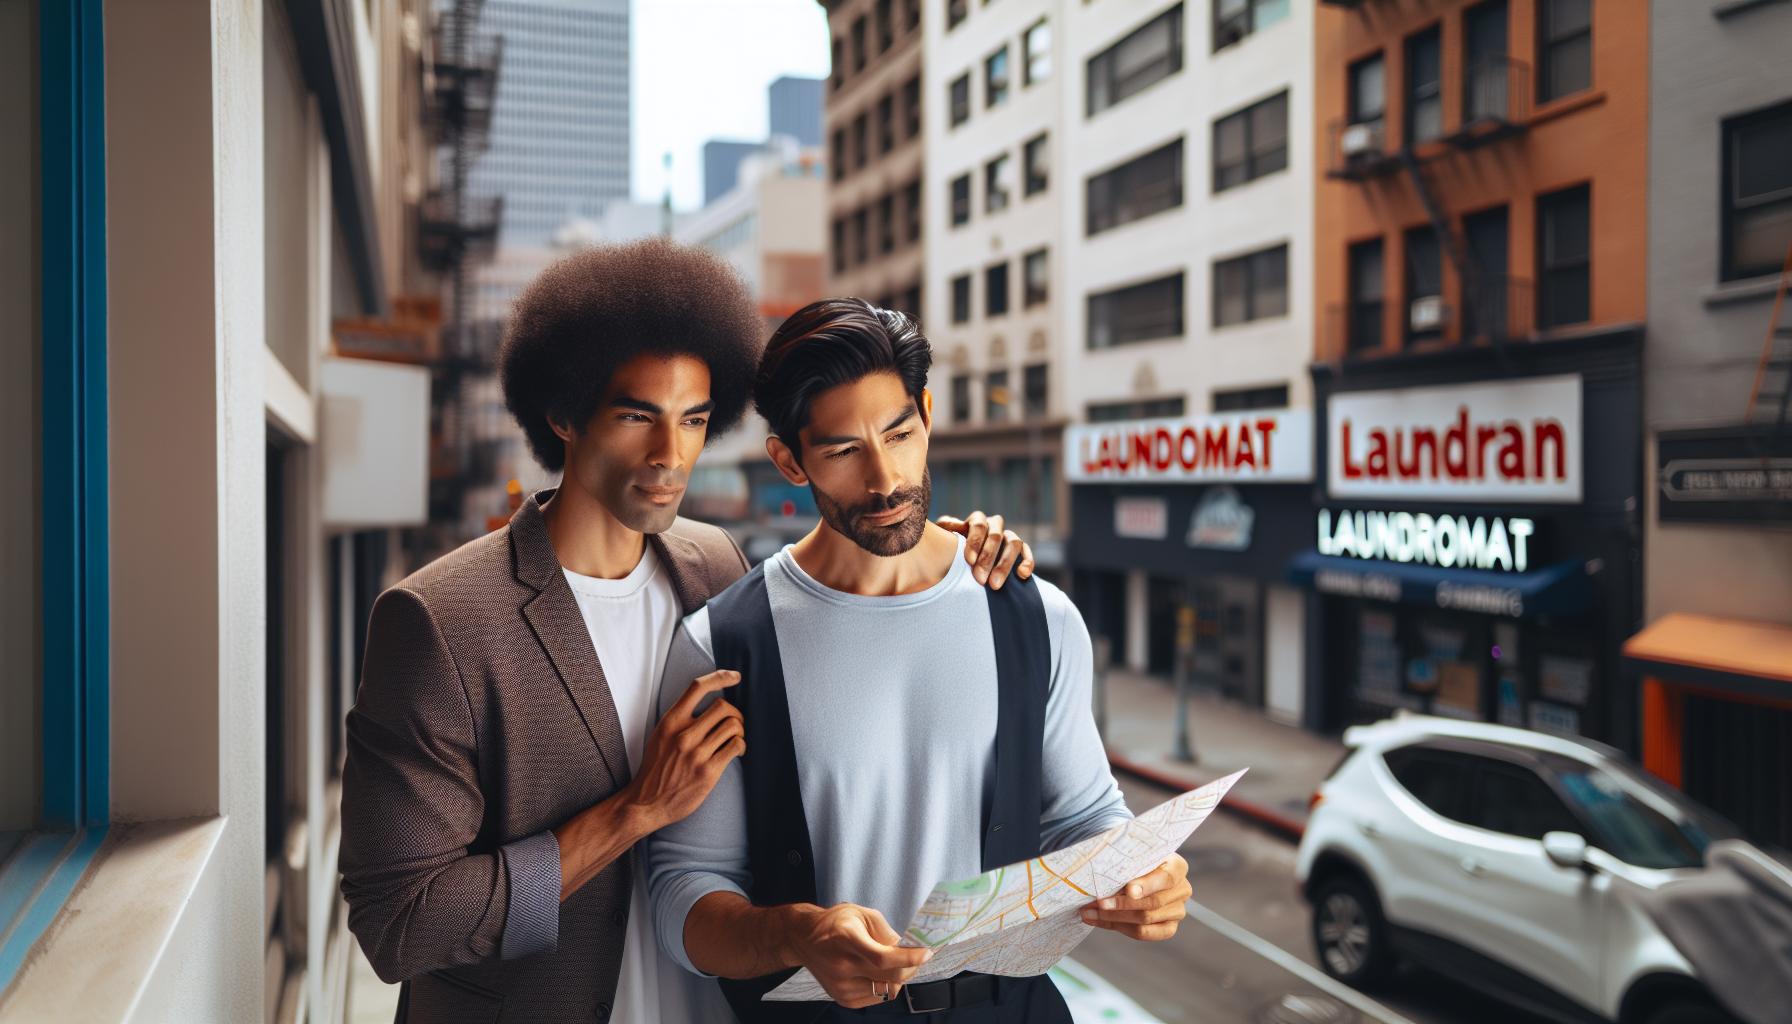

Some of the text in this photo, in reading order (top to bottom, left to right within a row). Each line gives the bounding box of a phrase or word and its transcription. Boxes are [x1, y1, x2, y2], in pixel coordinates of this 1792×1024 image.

[1082, 419, 1275, 474] LAUNDOMAT
[1342, 404, 1566, 480] Laundran
[1317, 507, 1535, 573] LAUNDROMAT
